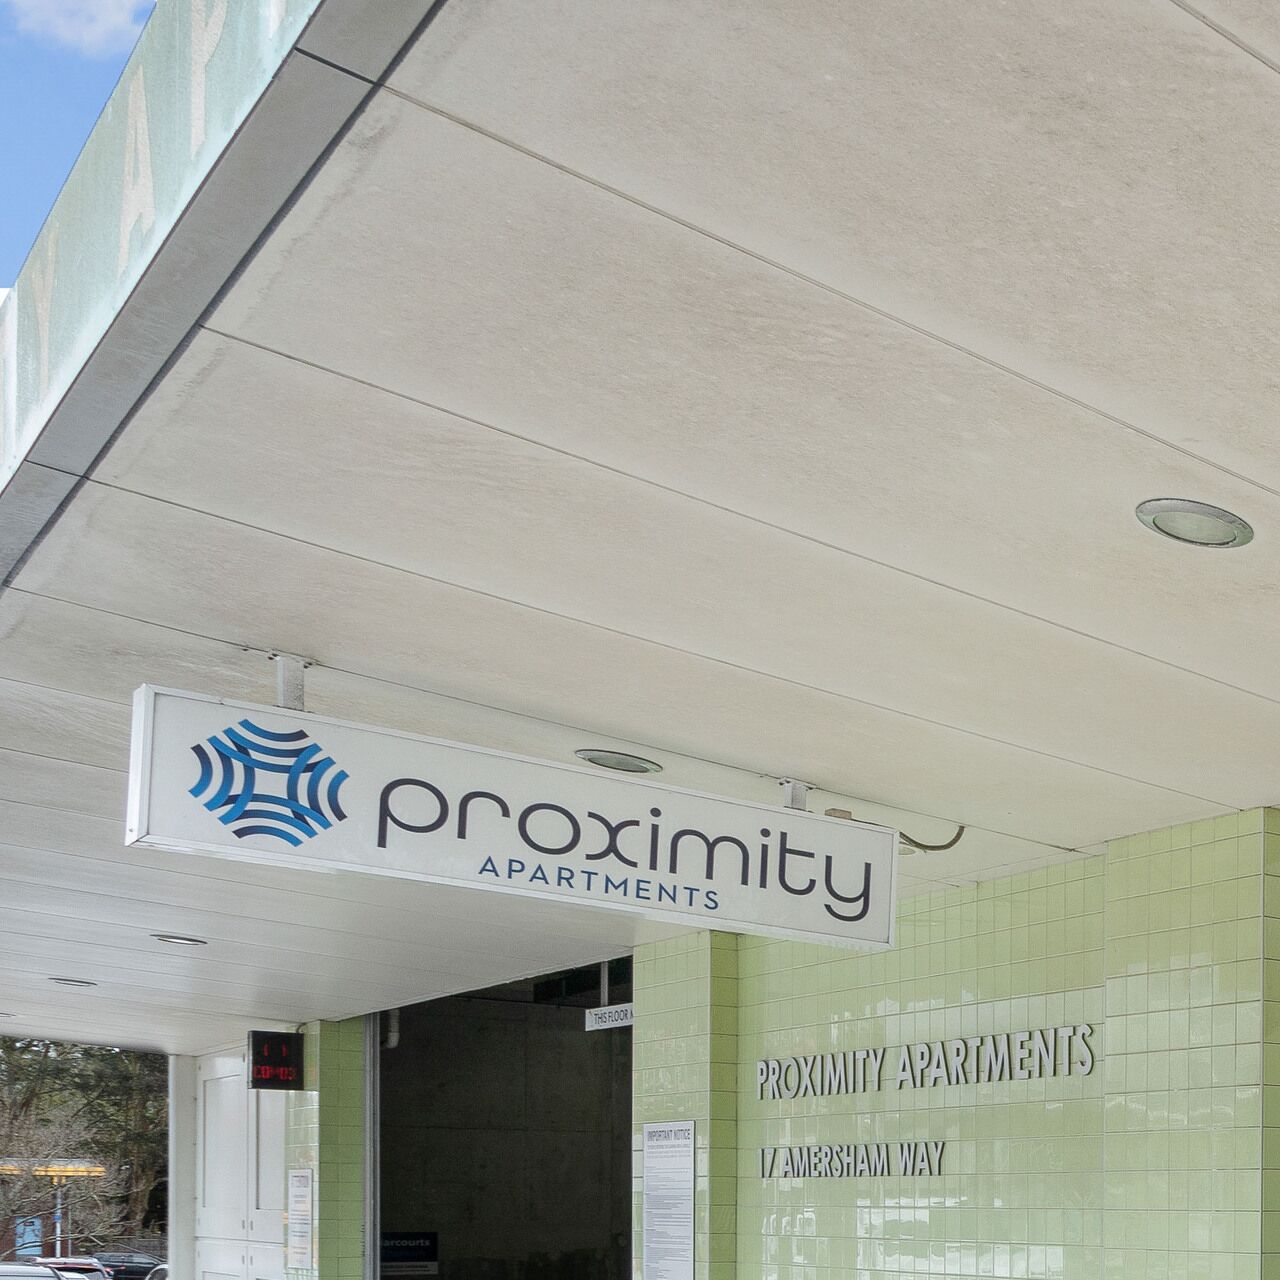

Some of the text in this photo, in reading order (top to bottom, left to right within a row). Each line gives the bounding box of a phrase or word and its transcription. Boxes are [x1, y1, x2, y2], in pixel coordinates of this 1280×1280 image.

[377, 778, 872, 923] proximity
[478, 855, 720, 911] APARTMENTS
[593, 1012, 607, 1025] THIS
[607, 1008, 629, 1022] FLOOR
[756, 1023, 1094, 1101] PROXIMITY APARTMENTS
[760, 1141, 947, 1179] 17 AMERSHAM WAY
